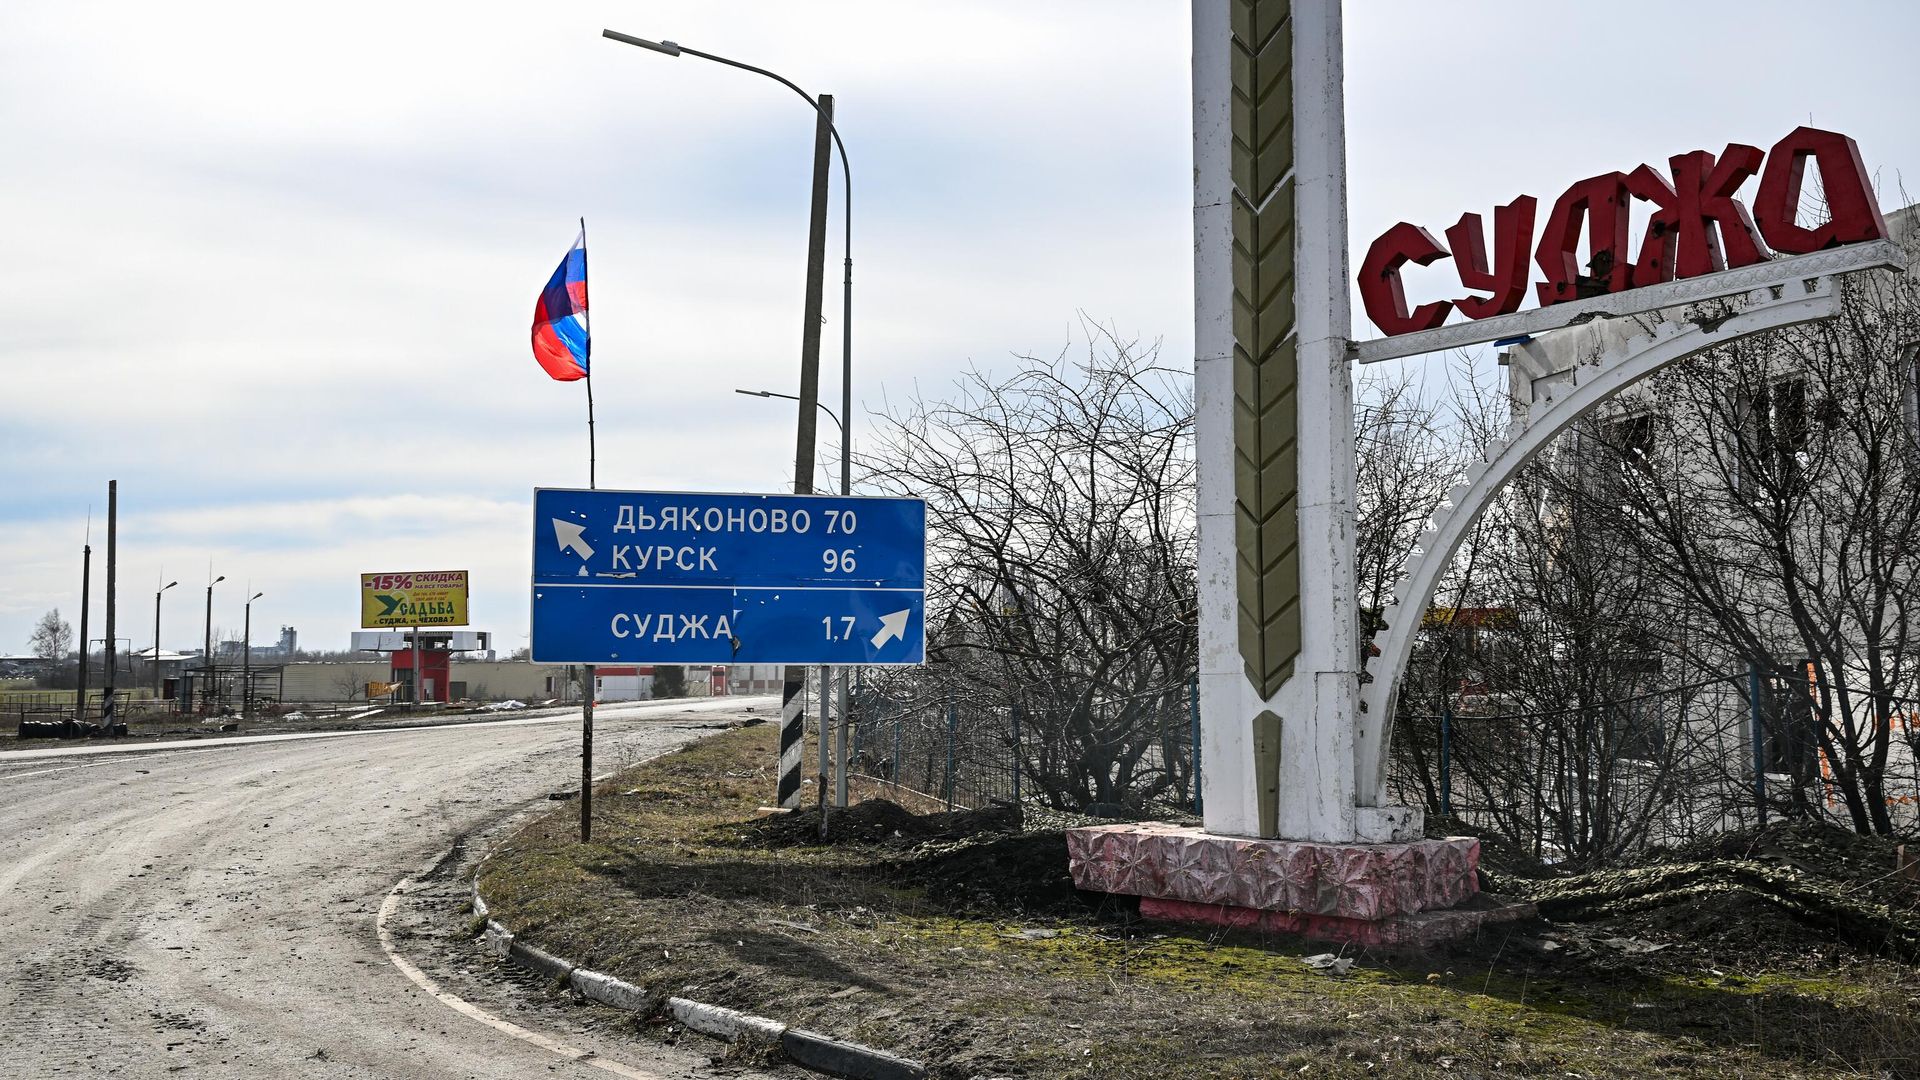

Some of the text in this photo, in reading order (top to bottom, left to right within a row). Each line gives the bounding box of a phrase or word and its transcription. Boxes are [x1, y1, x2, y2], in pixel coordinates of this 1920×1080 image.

[613, 505, 857, 534] ДЬЯКОНОВО 70
[612, 545, 856, 573] КУРСК 96
[364, 574, 414, 591] -15%
[415, 573, 464, 583] СКИДКА
[418, 616, 448, 624] ЧЕХОВА
[611, 613, 856, 644] СУДЖА 1,7
